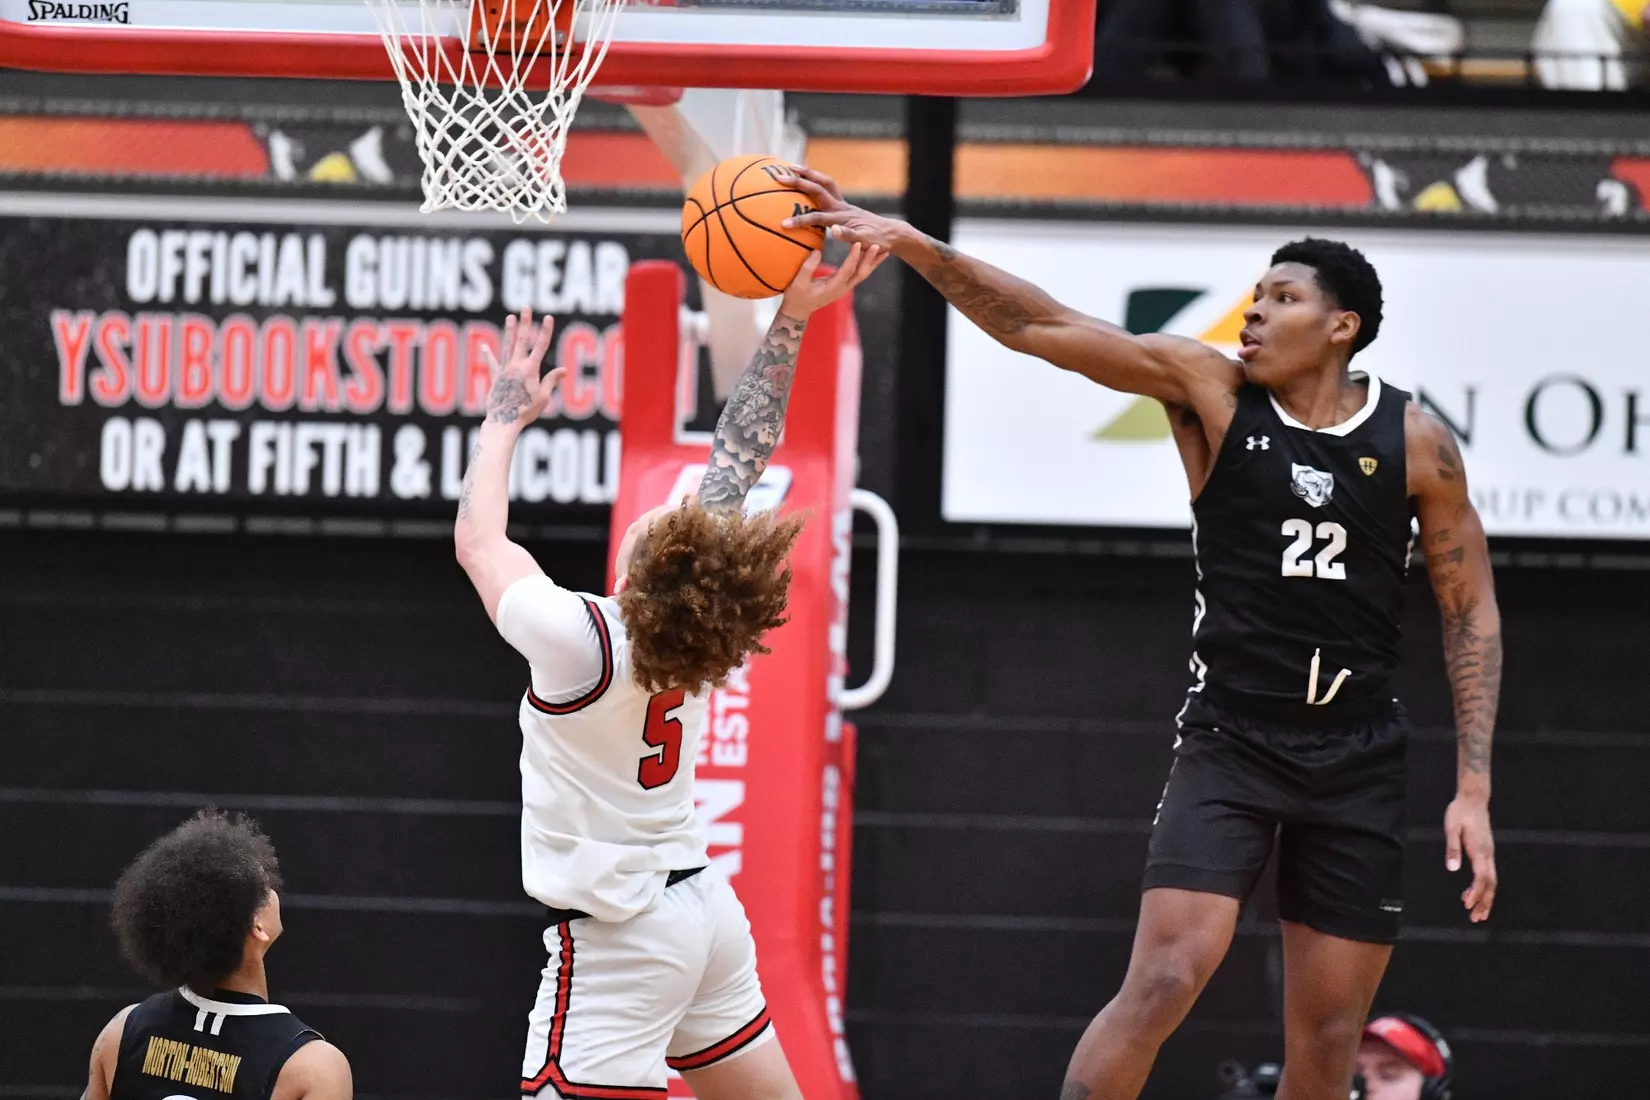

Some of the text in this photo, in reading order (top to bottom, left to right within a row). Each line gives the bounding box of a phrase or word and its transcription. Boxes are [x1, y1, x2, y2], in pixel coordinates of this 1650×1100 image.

[27, 0, 129, 24] SPALDING
[126, 229, 630, 316] OFFICIAL GUINS GEAR
[100, 418, 165, 494] OR
[174, 420, 241, 495] AT
[248, 421, 384, 498] FIFTH
[390, 427, 432, 498] &
[1281, 518, 1347, 580] 22
[637, 687, 684, 791] 5
[142, 1035, 242, 1094] NORTON-ROBERTSON
